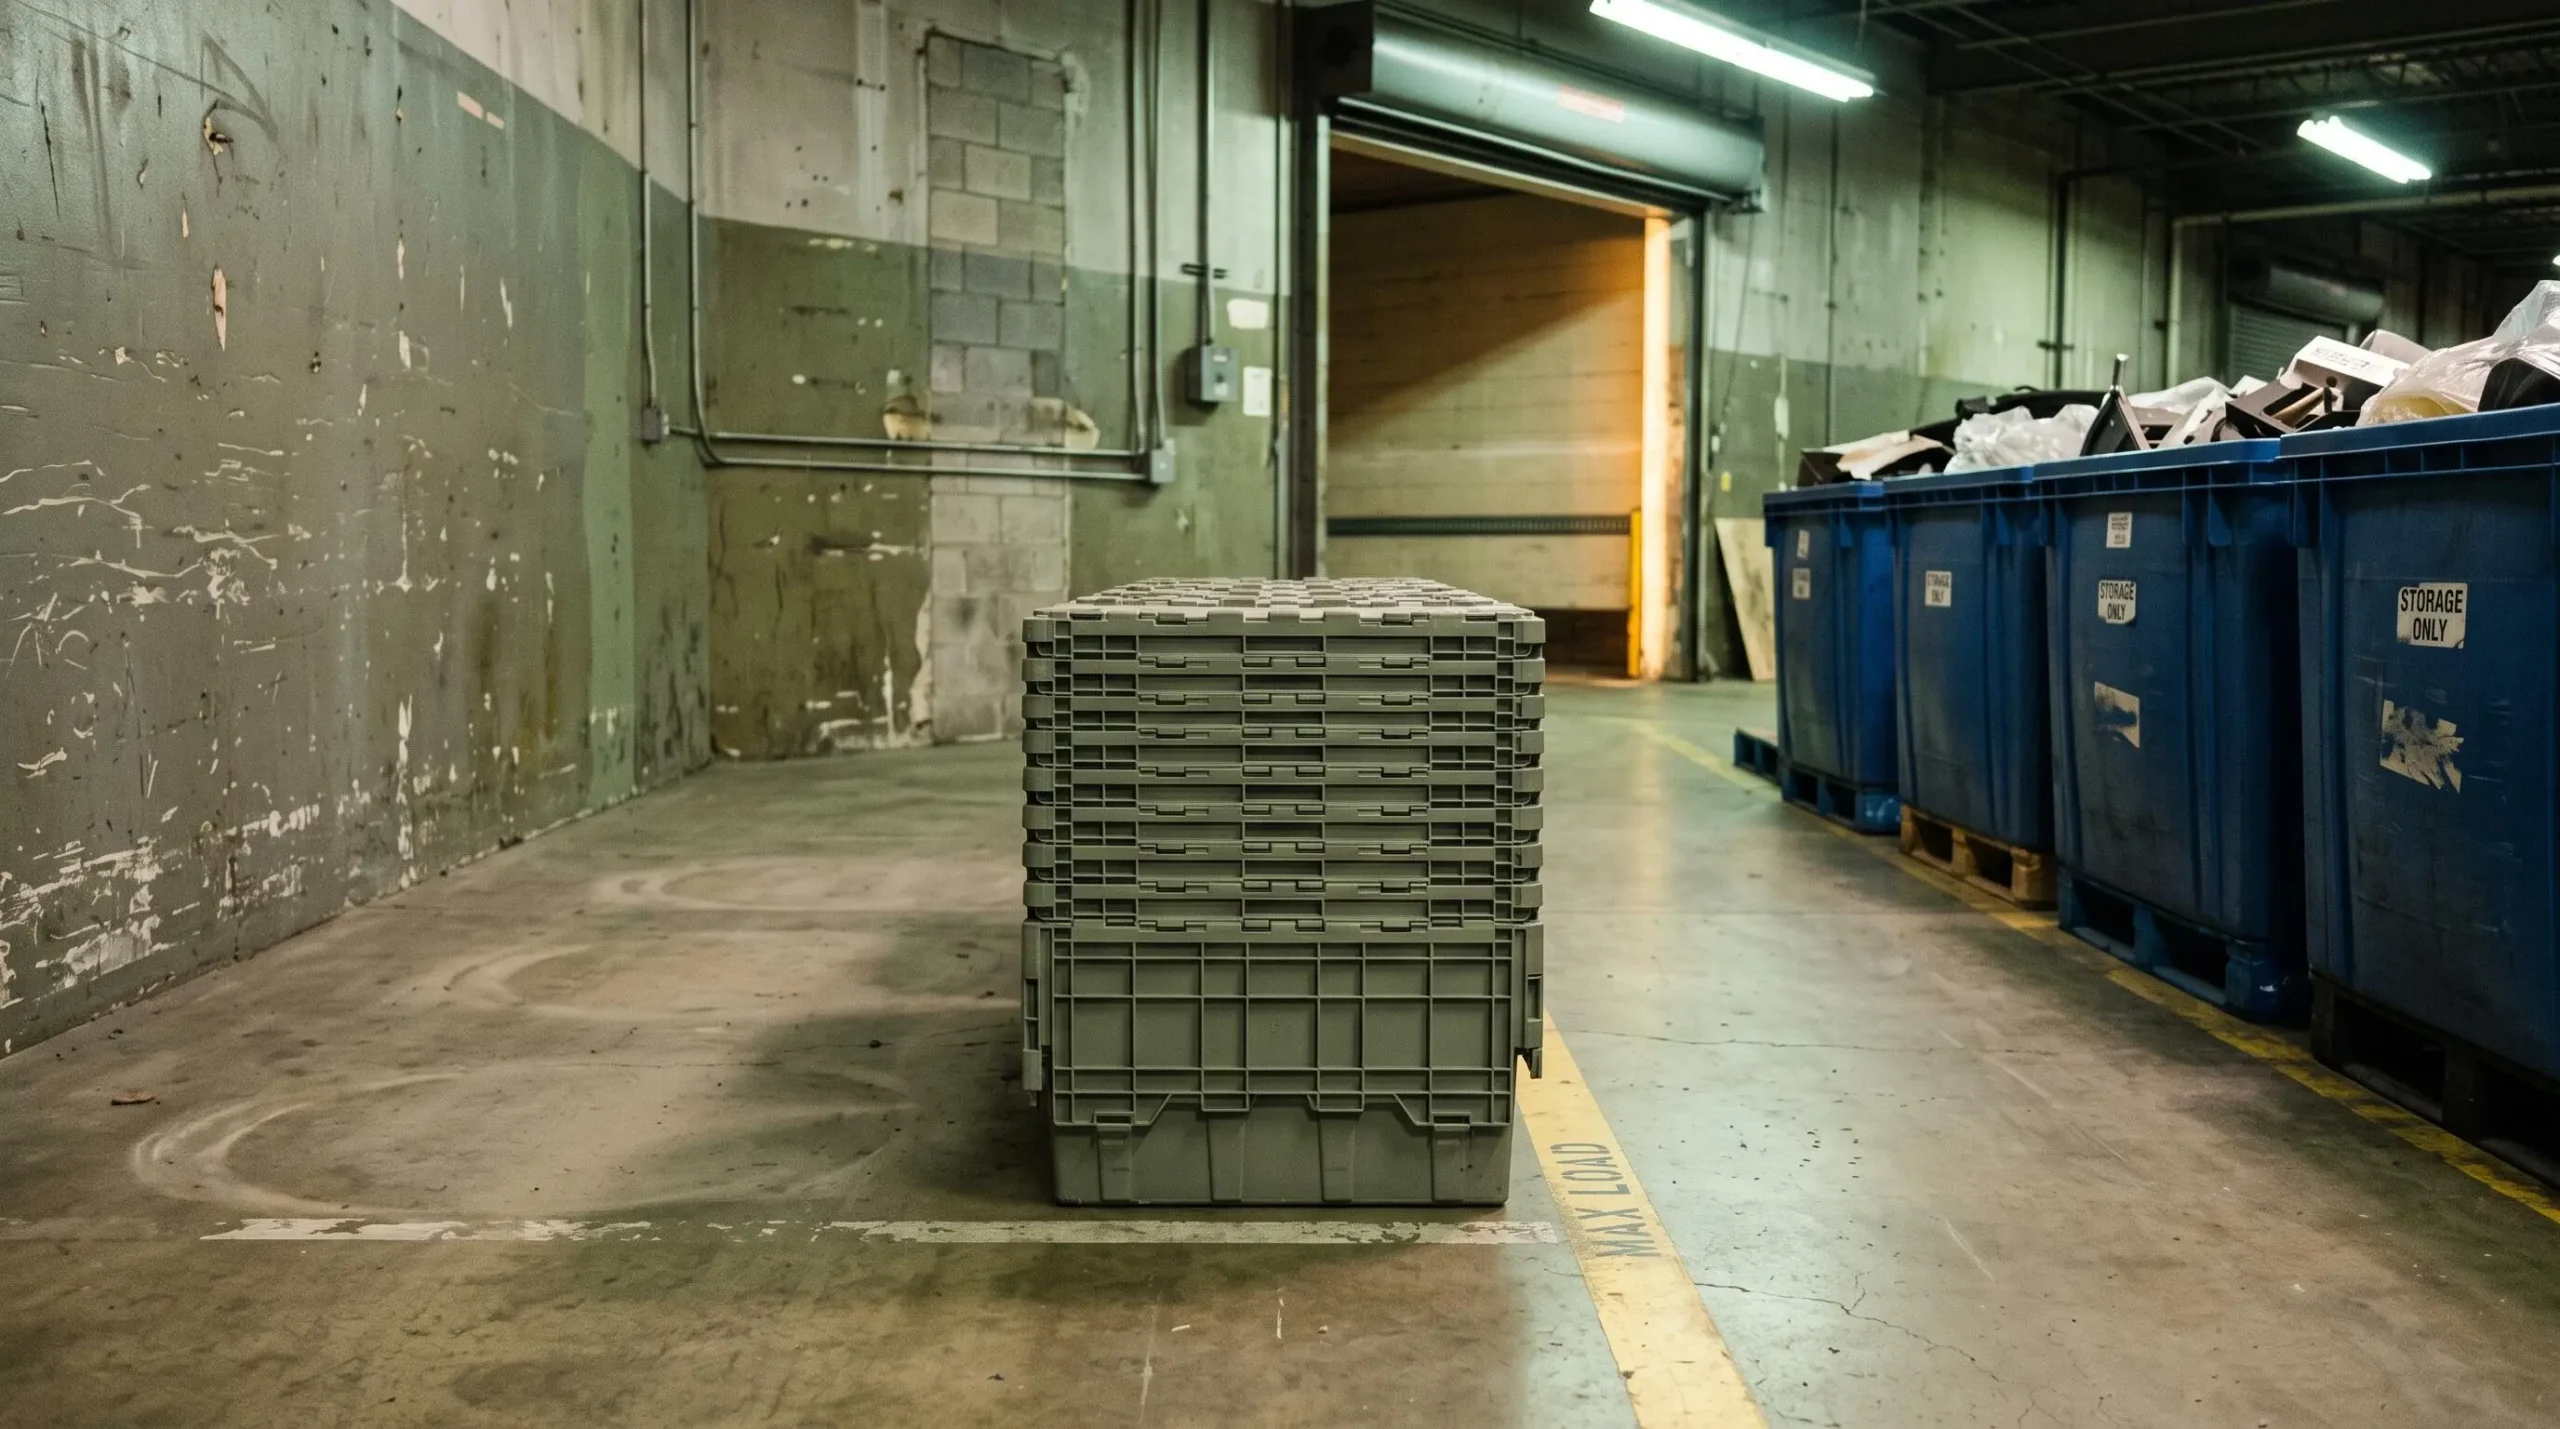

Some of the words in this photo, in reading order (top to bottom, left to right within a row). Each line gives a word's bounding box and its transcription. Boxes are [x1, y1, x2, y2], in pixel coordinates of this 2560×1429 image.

[2100, 582, 2134, 601] STORAGE
[2400, 588, 2464, 614] STORAGE
[2107, 603, 2126, 621] ONLY
[2413, 617, 2448, 642] ONLY
[1550, 1142, 1631, 1195] LOAD
[1574, 1206, 1661, 1257] MAX
